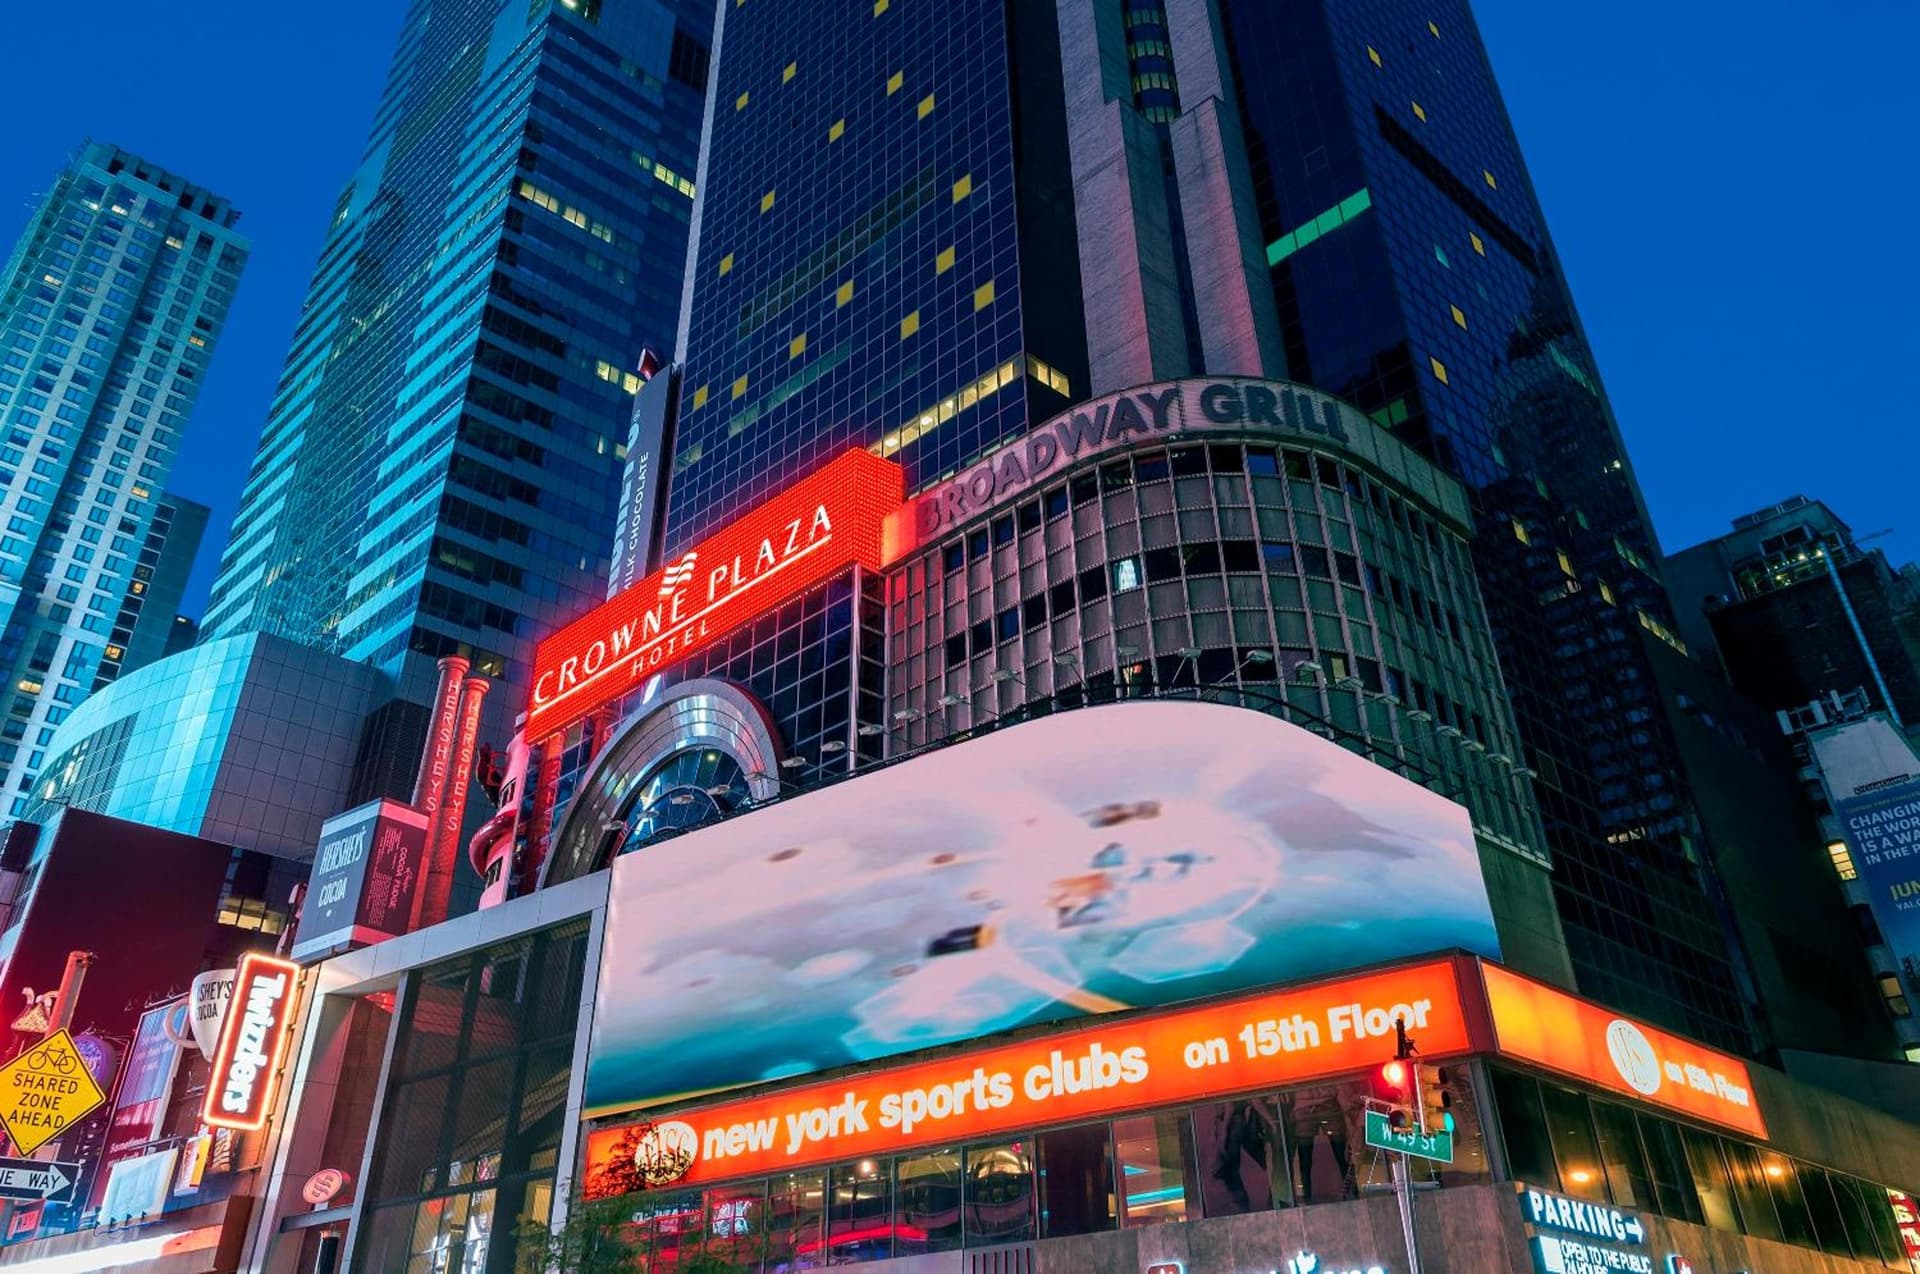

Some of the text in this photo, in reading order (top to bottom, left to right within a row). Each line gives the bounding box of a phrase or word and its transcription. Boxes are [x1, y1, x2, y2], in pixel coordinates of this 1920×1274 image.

[916, 384, 1349, 534] BROADWAY GRILL
[629, 452, 648, 551] CHOCOLATE
[534, 588, 687, 704] CROWNE
[708, 504, 832, 601] PLAZA
[632, 618, 710, 678] HOTEL
[1855, 827, 1883, 843] THE
[1861, 839, 1878, 855] IS
[1881, 836, 1894, 850] A
[1865, 853, 1881, 865] IN
[1882, 847, 1911, 861] THE
[197, 980, 233, 1002] SHEY'S
[1184, 999, 1432, 1069] on 15th Floor
[12, 1073, 78, 1095] SHARED
[19, 1092, 60, 1111] ZONE
[703, 1116, 778, 1160] new
[785, 1092, 869, 1152] york
[879, 1066, 1014, 1134] sports
[1024, 1043, 1149, 1100] clubs
[8, 1109, 65, 1130] AHEAD
[1381, 1122, 1392, 1142] W
[1421, 1135, 1436, 1152] St
[28, 1172, 61, 1190] WAY
[1529, 1190, 1626, 1240] PARKING
[1561, 1240, 1588, 1263] OPEN
[1588, 1246, 1602, 1266] TO
[1602, 1249, 1620, 1268] THE
